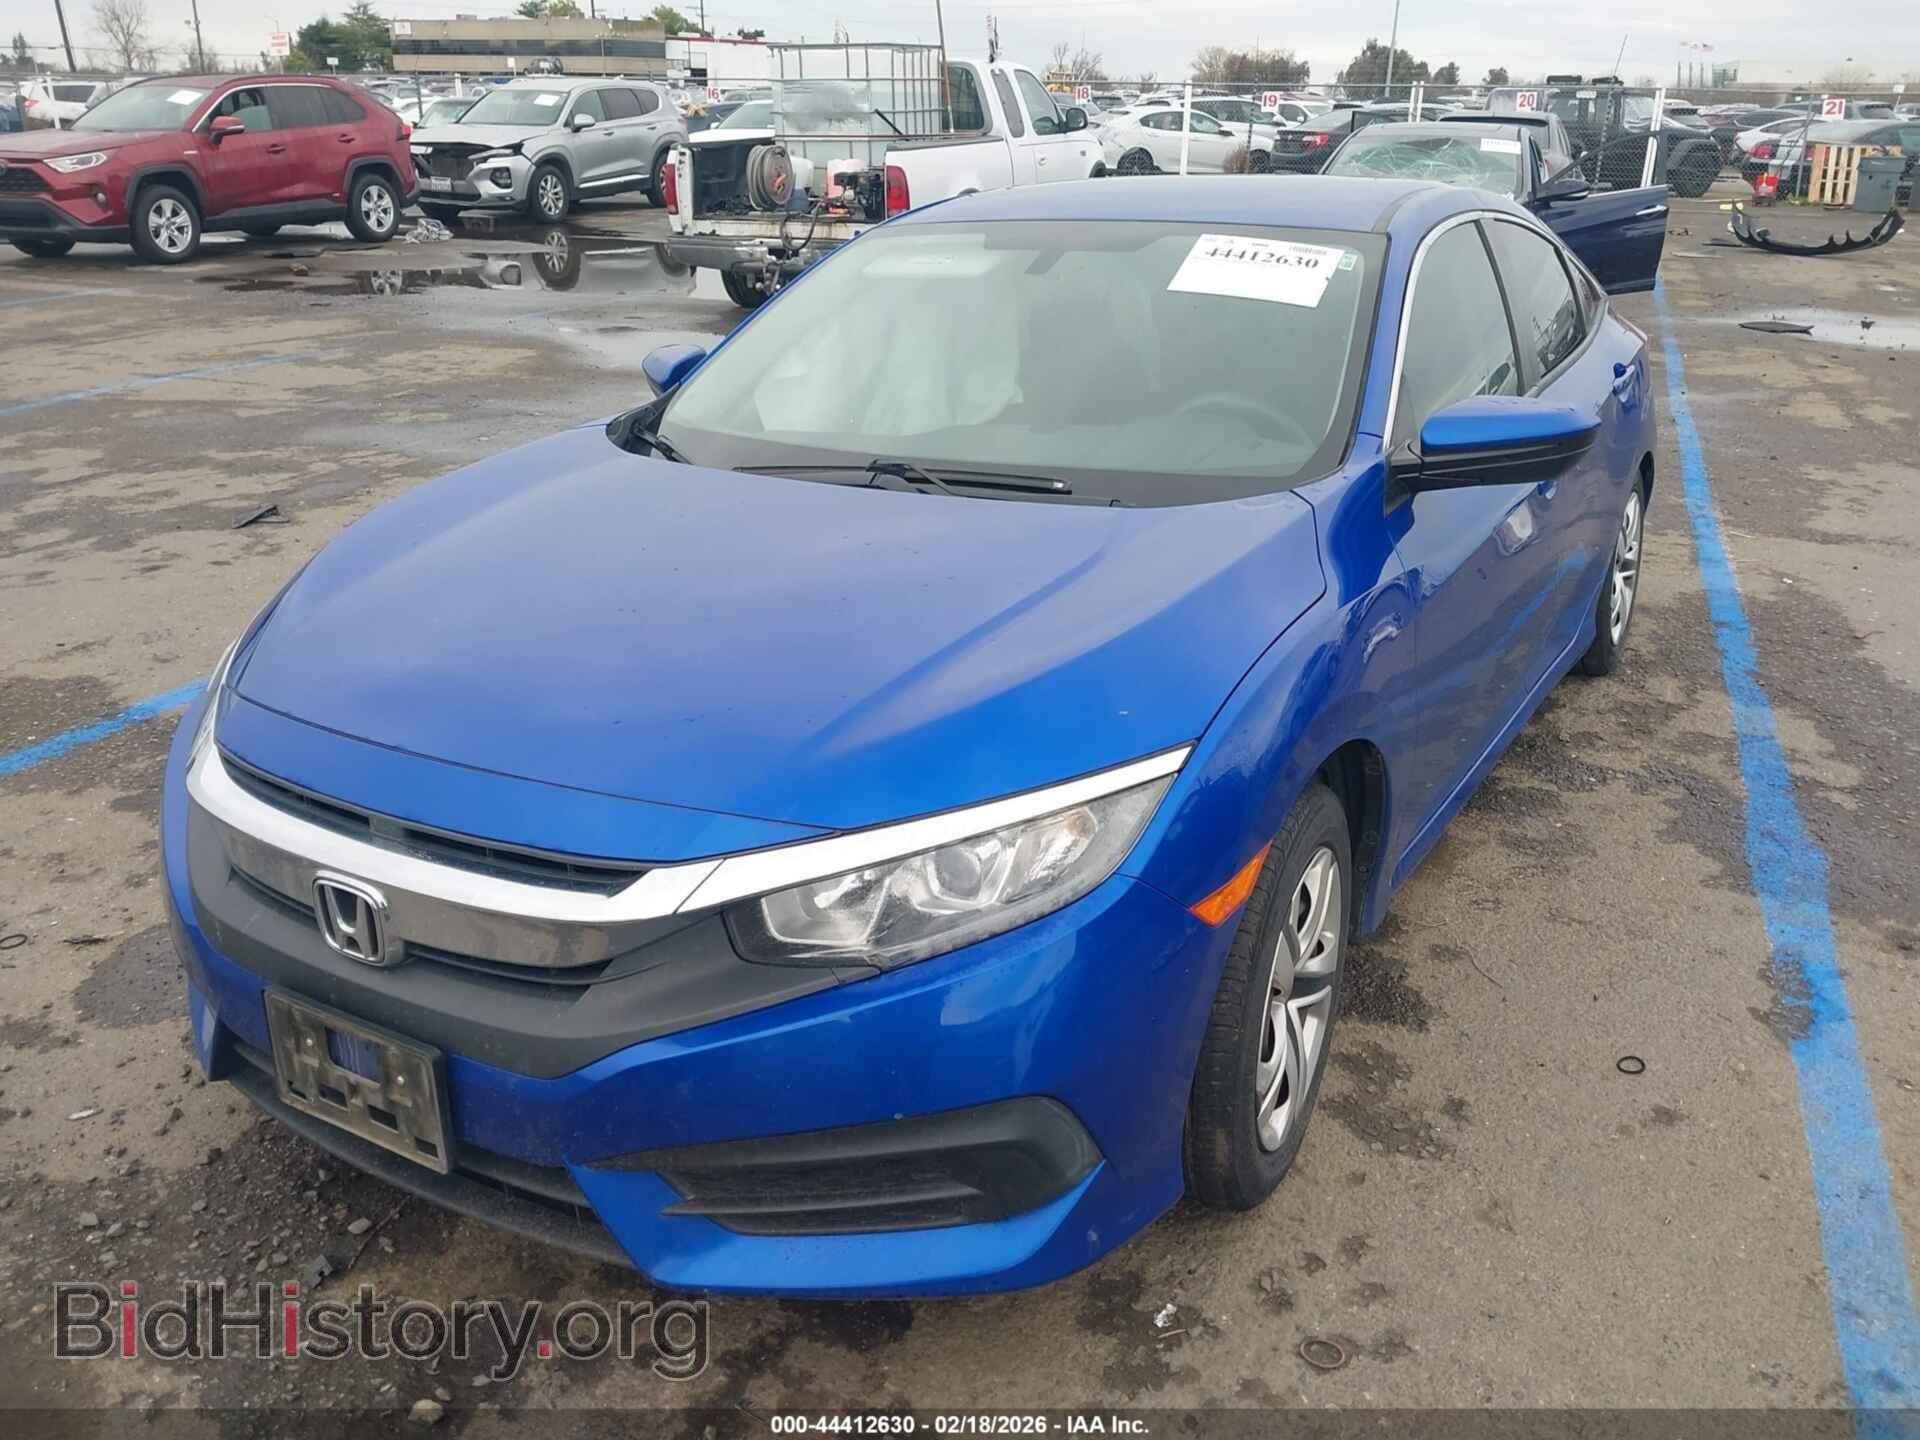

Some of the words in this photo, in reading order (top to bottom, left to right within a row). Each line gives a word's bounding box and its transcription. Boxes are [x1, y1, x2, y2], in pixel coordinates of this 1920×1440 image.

[708, 87, 719, 99] 16
[1077, 87, 1088, 99] 18
[1264, 95, 1277, 107] 19
[1519, 94, 1535, 107] 20
[1825, 101, 1843, 115] 21
[1205, 247, 1319, 269] 44412630
